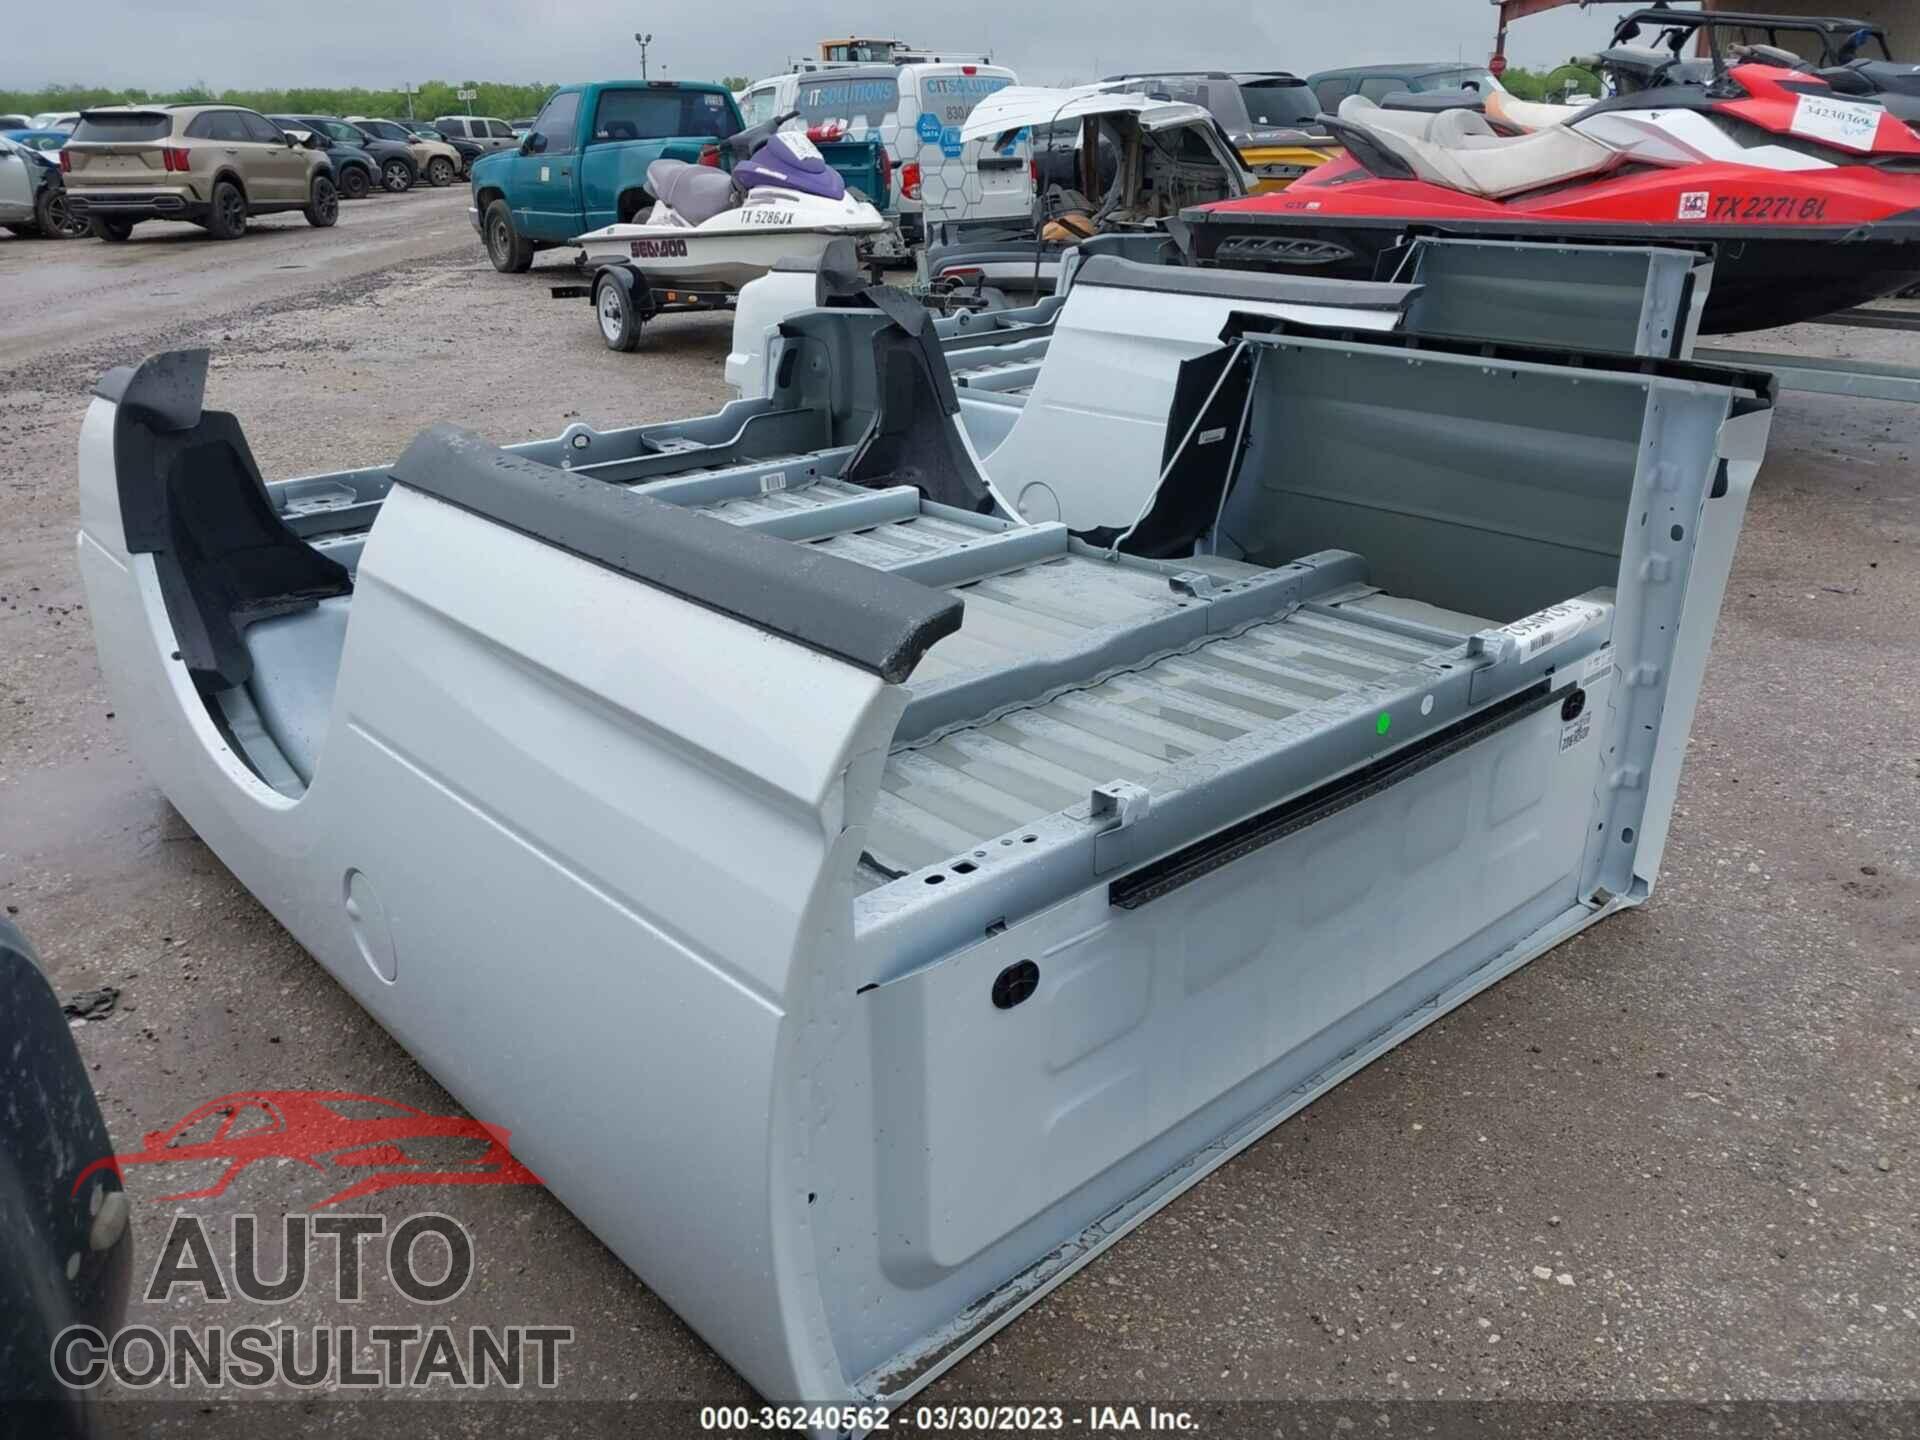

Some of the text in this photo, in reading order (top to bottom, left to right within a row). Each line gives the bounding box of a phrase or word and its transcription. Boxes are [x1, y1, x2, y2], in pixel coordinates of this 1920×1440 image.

[1713, 196, 1743, 218] TX
[1743, 196, 1797, 218] 2271
[740, 210, 752, 224] TX
